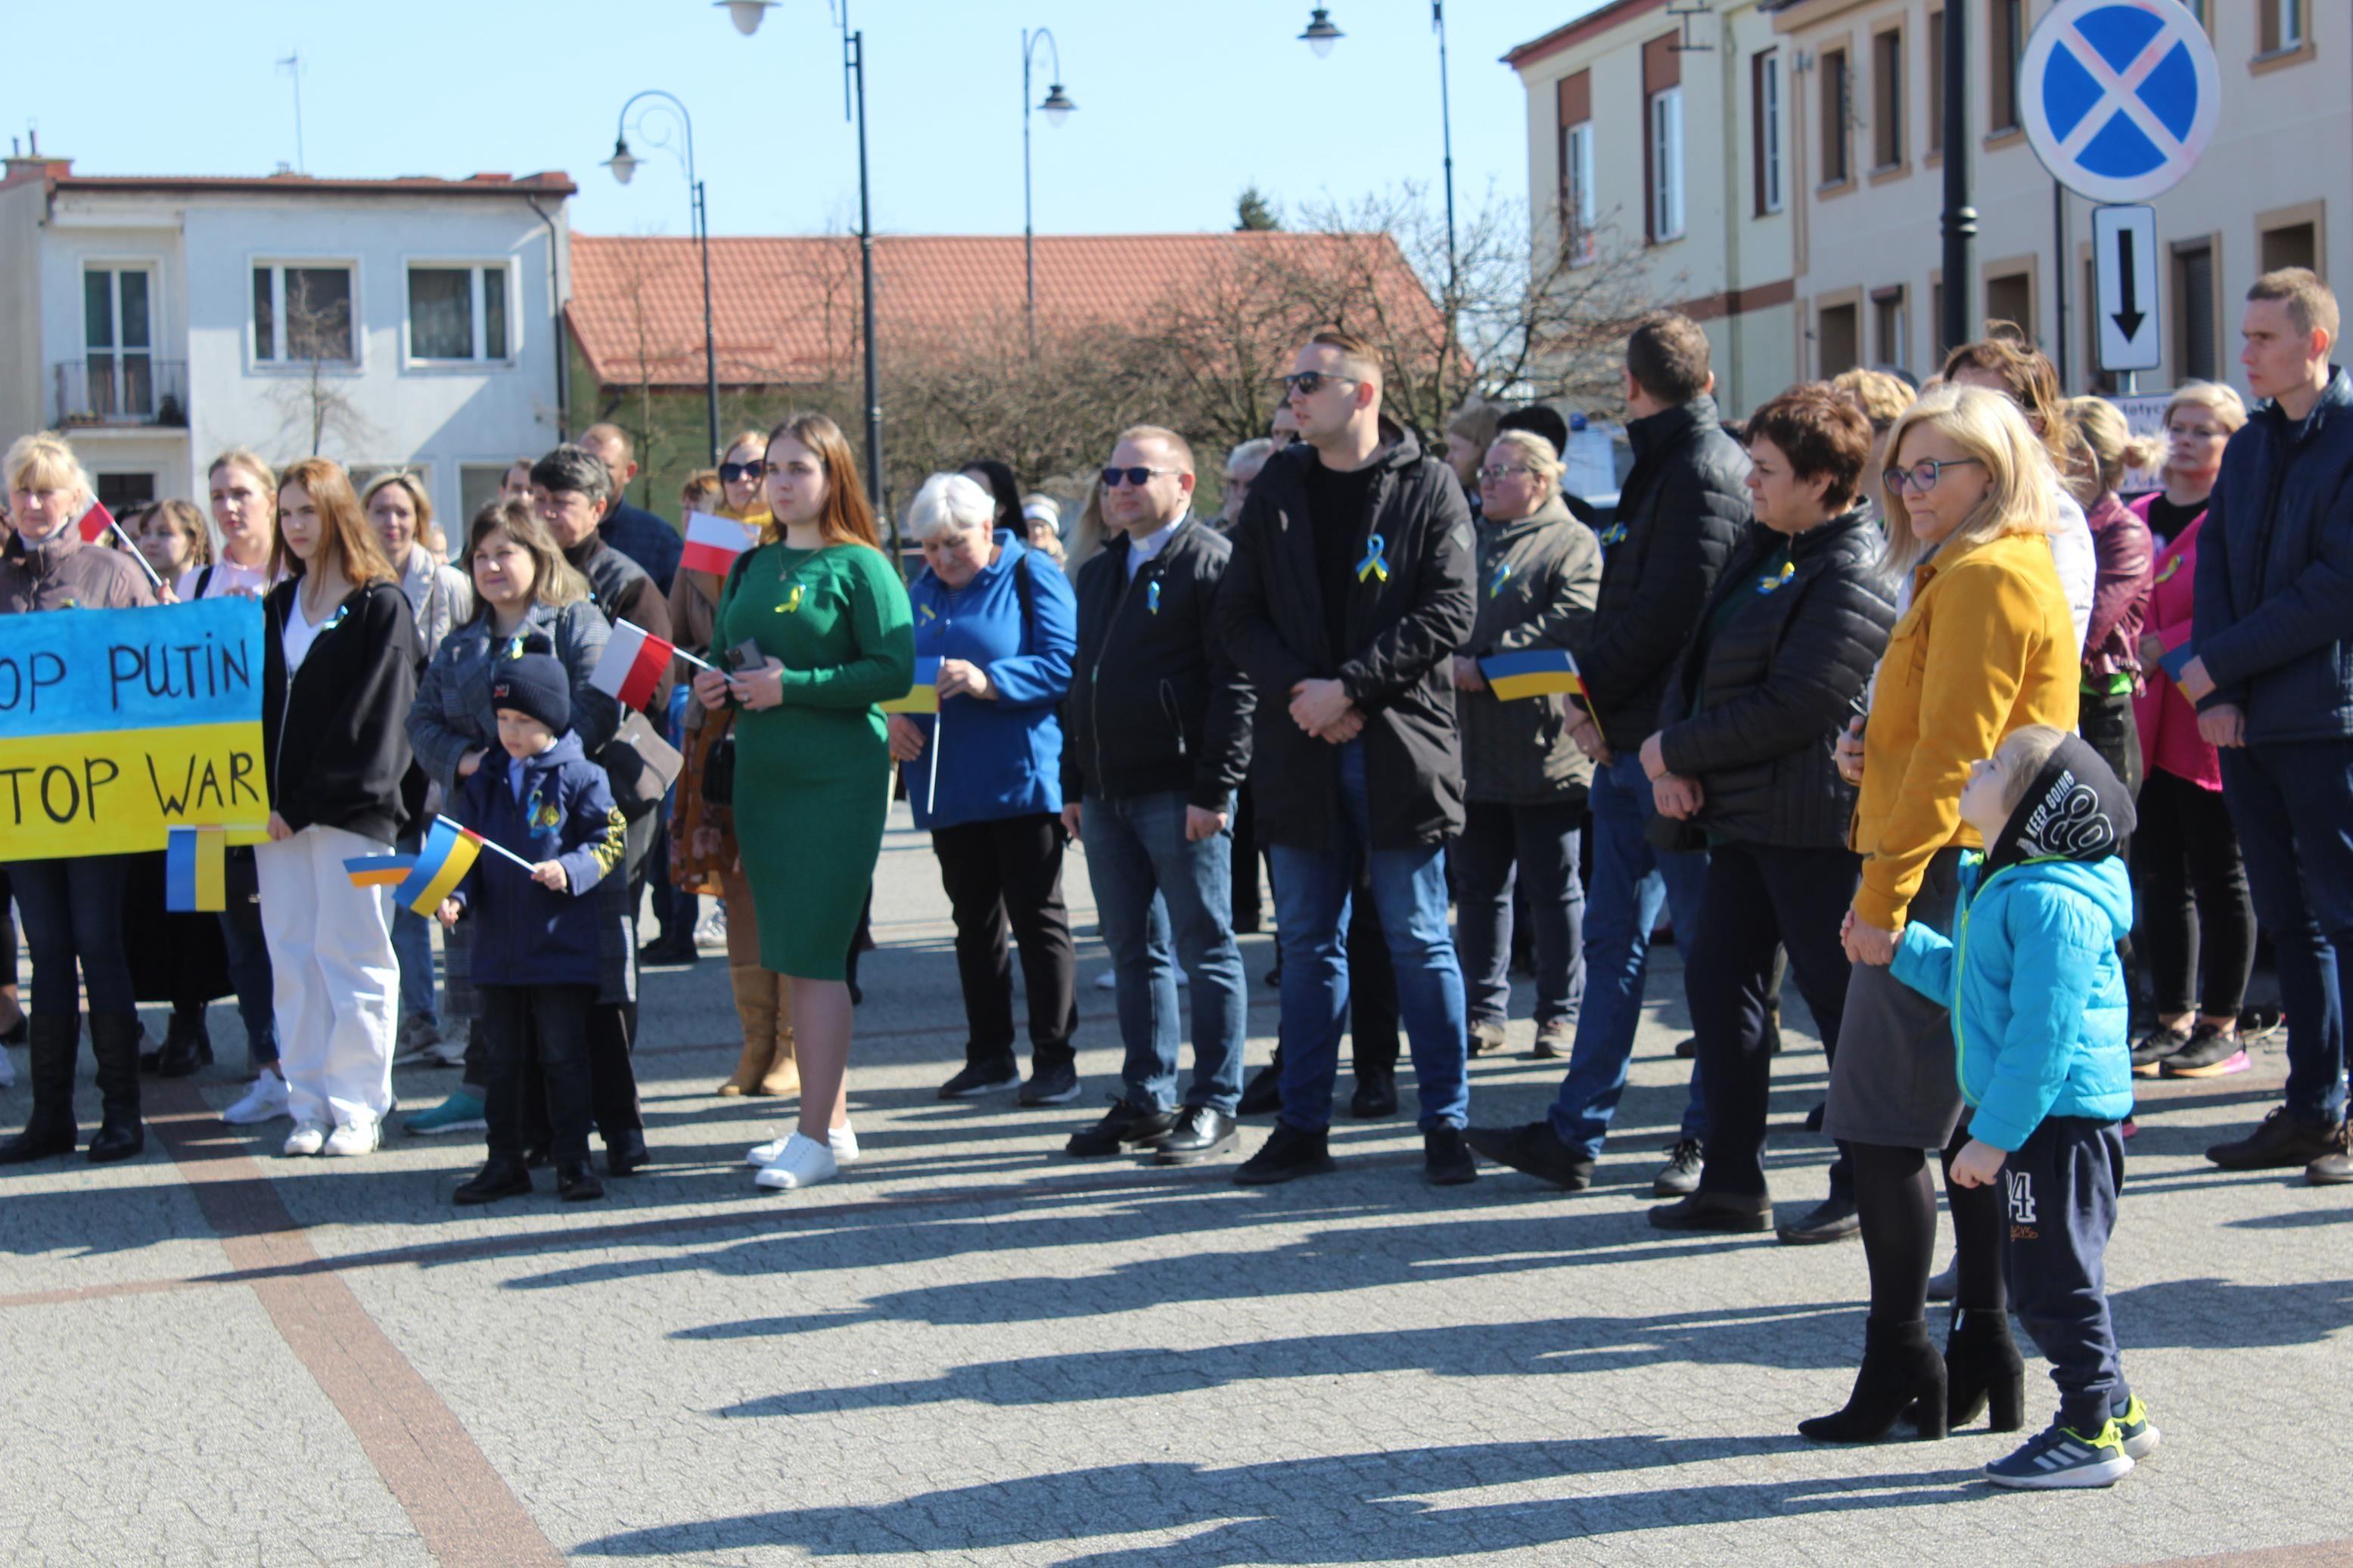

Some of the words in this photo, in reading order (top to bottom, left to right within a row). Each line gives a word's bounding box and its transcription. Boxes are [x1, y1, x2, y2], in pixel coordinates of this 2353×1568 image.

[145, 750, 260, 817] WAR
[2025, 803, 2048, 839] KEEP
[2045, 769, 2075, 810] GOING
